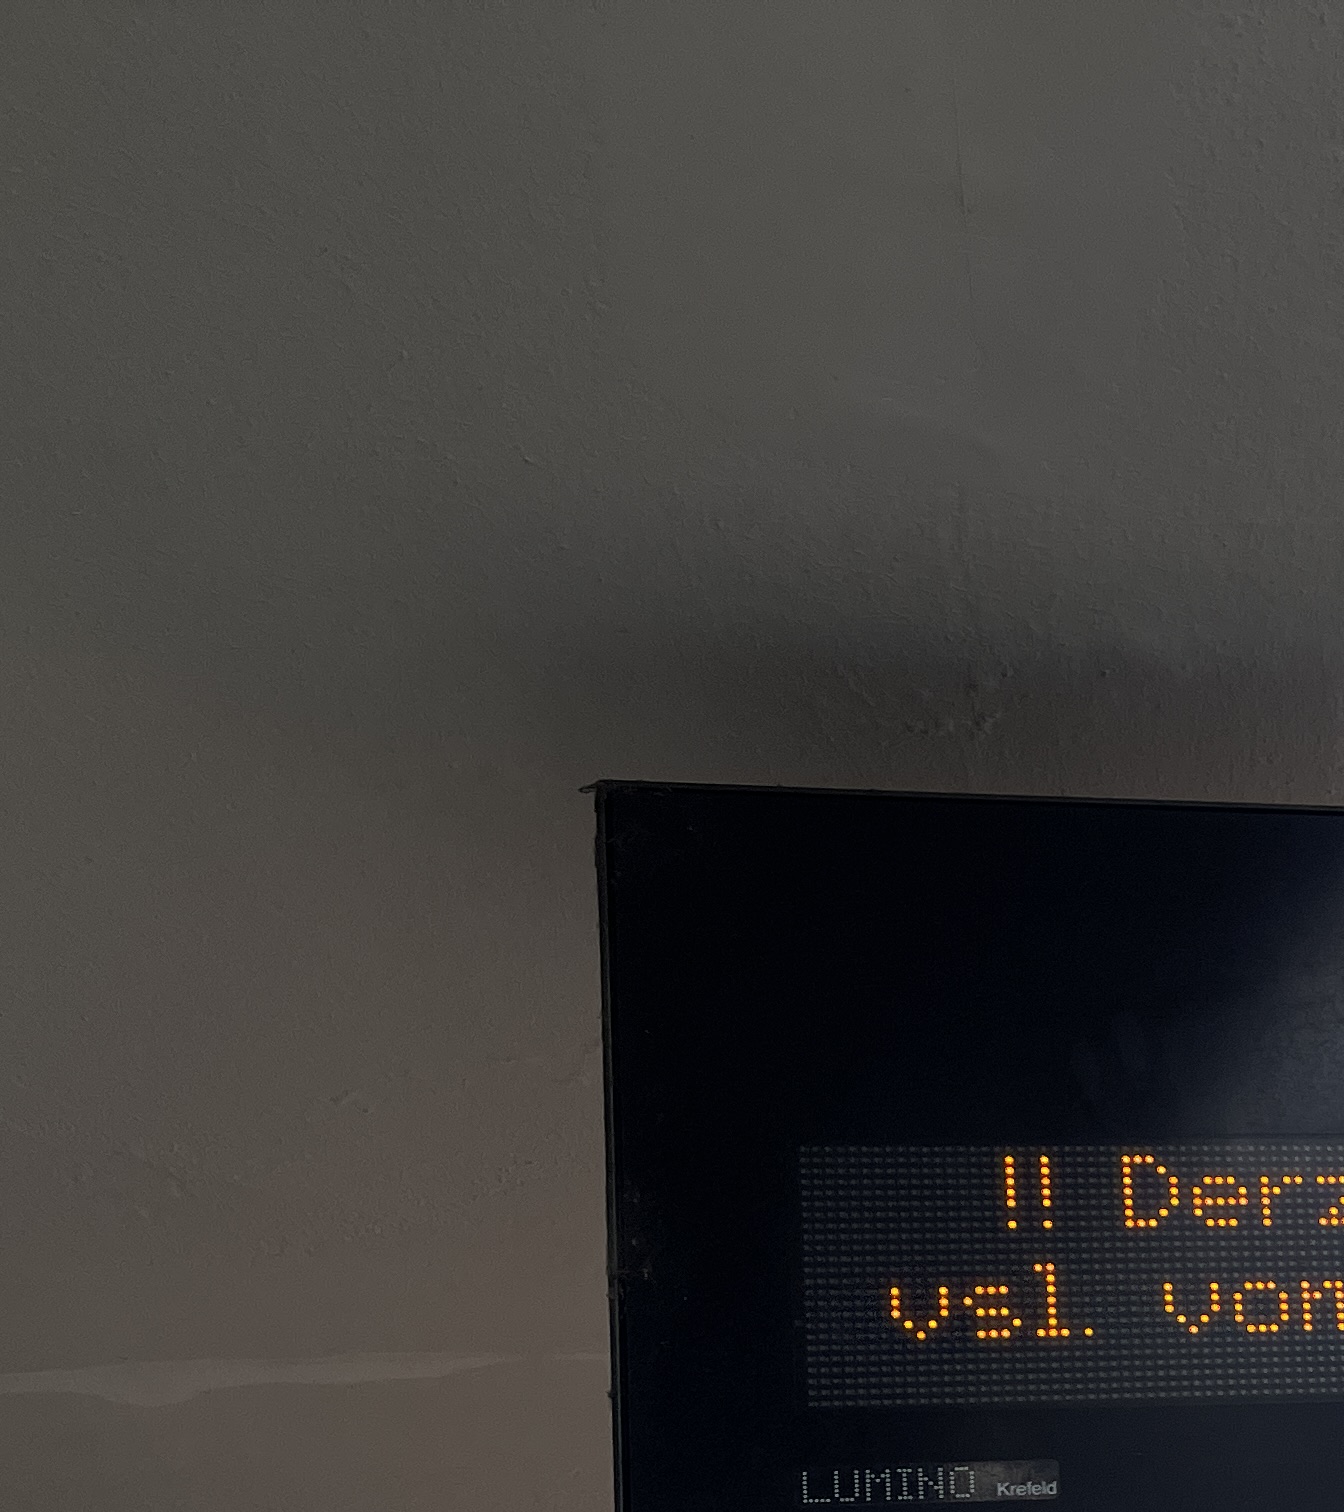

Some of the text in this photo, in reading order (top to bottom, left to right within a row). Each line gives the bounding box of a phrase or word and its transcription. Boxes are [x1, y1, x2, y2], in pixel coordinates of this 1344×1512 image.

[1004, 1155, 1053, 1229] !!
[889, 1262, 1094, 1340] vsl.
[802, 1466, 1058, 1503] LUMINO Krefeld
